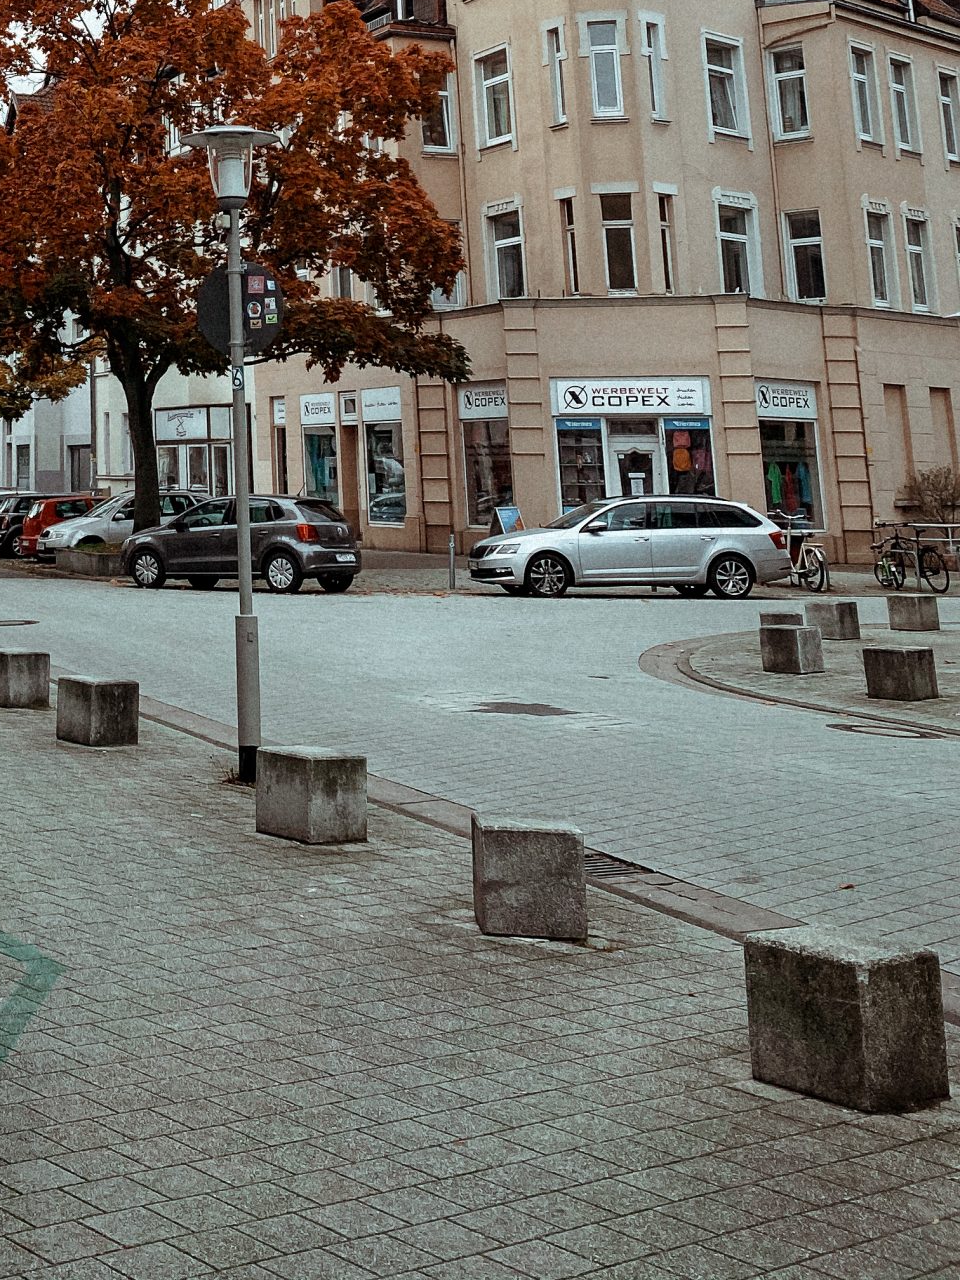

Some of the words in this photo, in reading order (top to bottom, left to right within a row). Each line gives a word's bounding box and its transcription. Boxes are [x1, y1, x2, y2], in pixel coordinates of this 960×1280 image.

[591, 387, 669, 395] WERBEWELT
[474, 397, 506, 407] COPEX
[591, 395, 671, 407] COPEX
[772, 396, 810, 408] COPEX
[310, 406, 332, 415] COPEX
